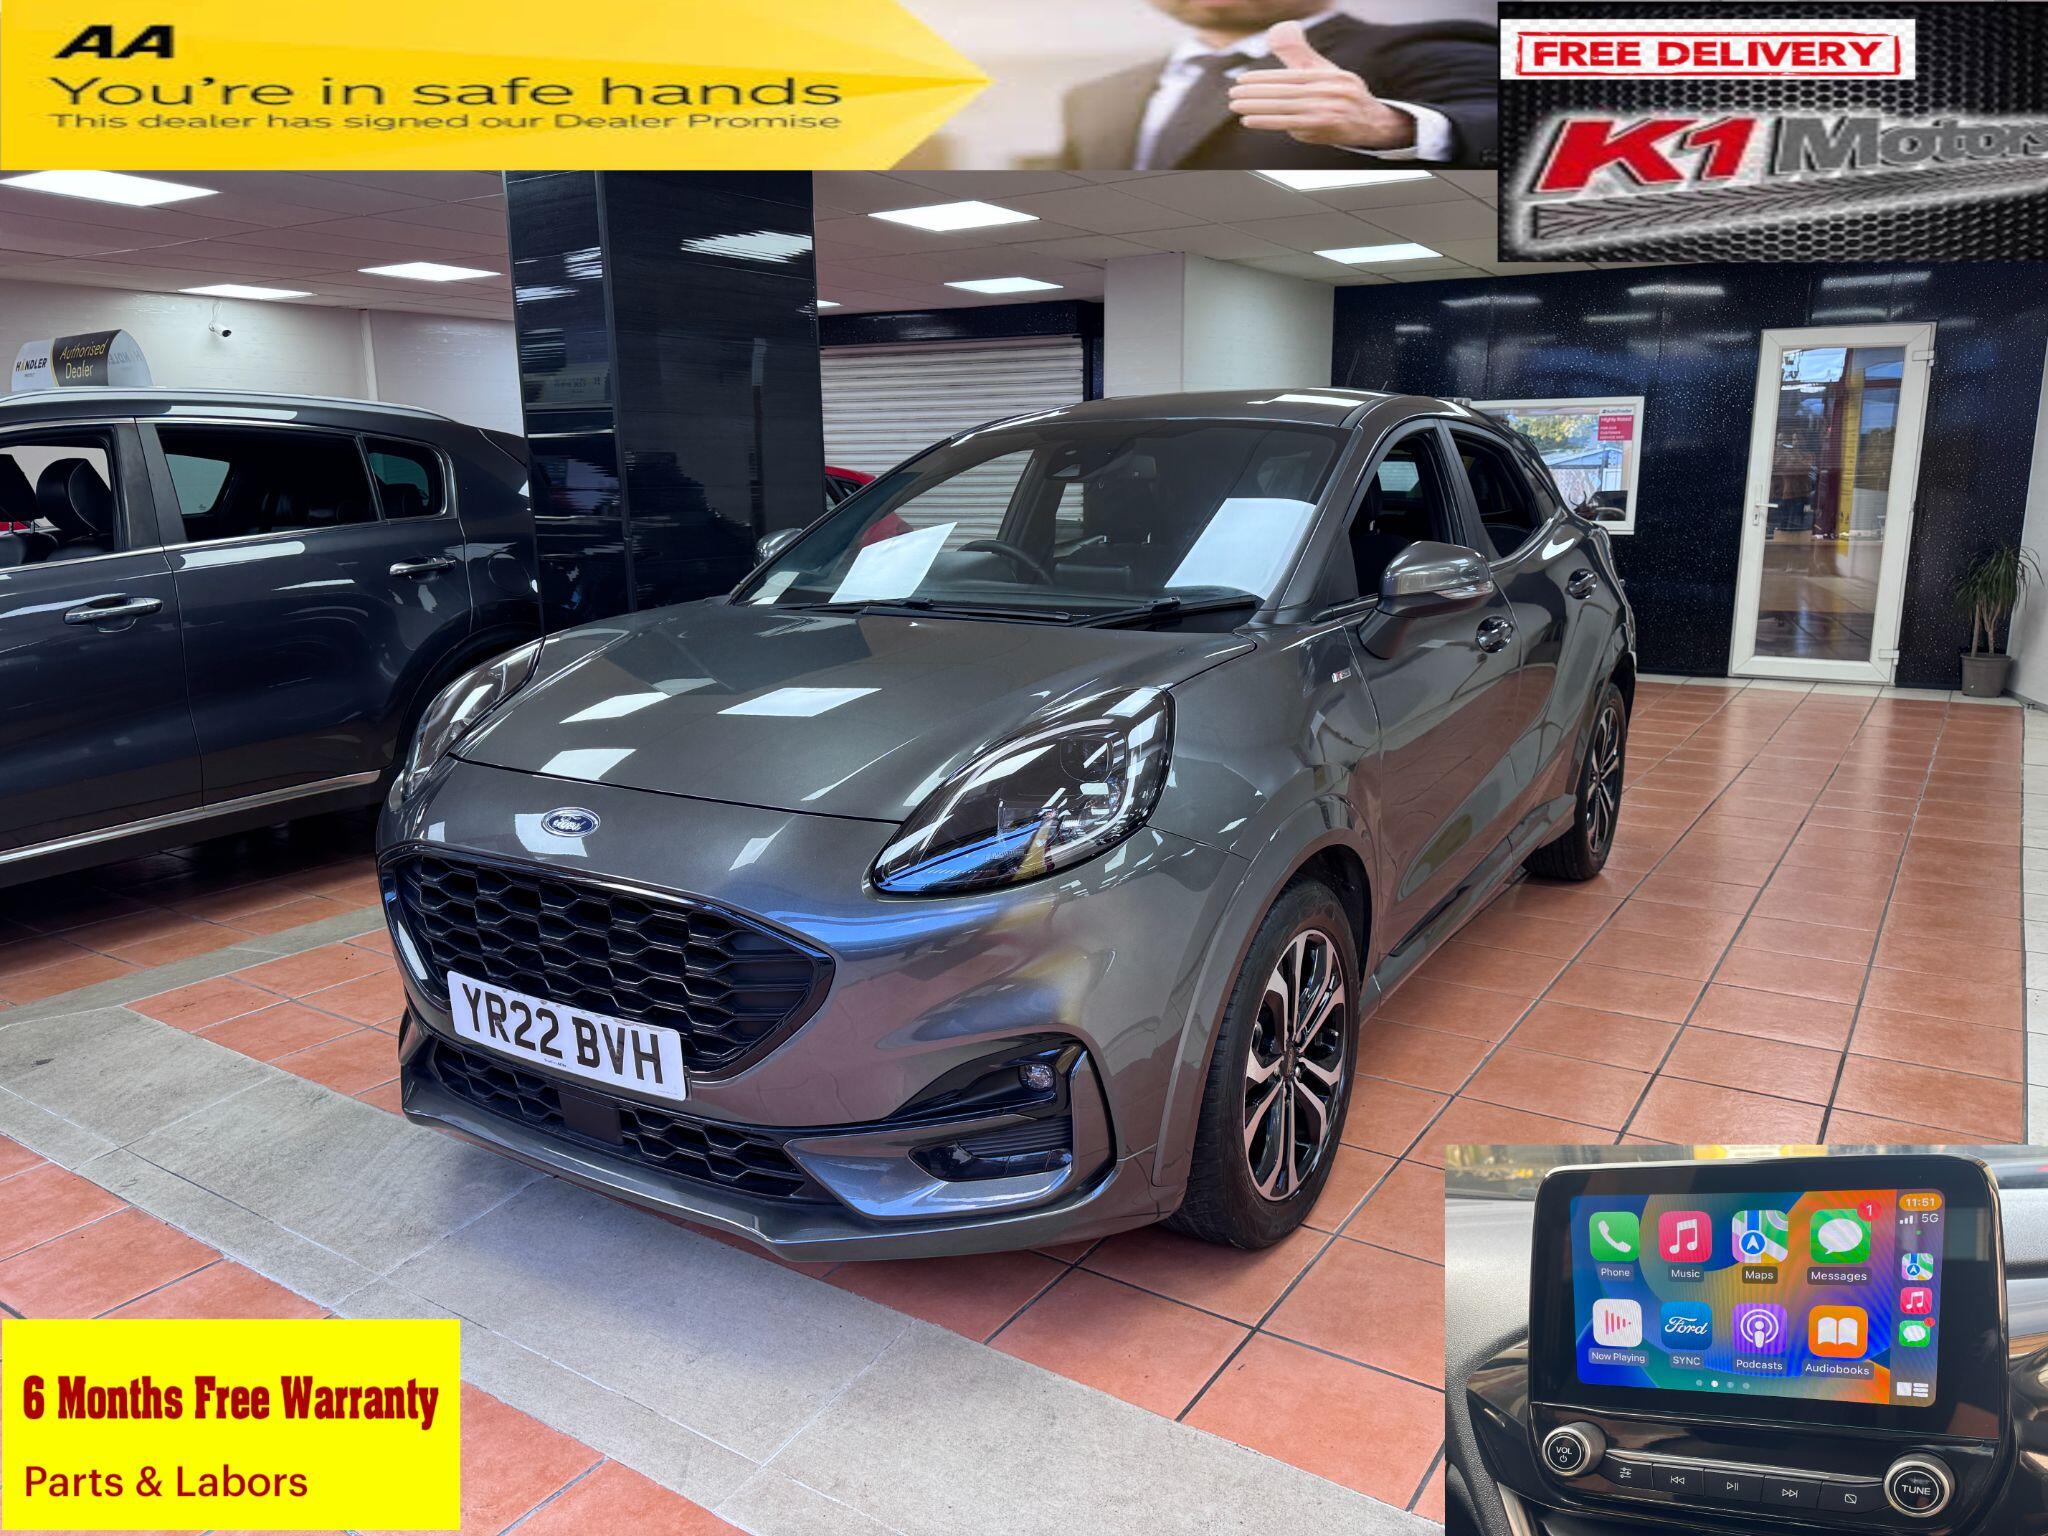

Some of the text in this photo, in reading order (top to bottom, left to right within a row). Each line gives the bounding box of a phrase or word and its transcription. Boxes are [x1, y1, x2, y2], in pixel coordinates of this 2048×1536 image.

[60, 338, 109, 361] Authorised
[65, 362, 94, 380] Dealer
[462, 983, 664, 1084] YR22 BVH
[1905, 1197, 1936, 1208] 11:51
[1866, 1204, 1873, 1217] 1
[1921, 1213, 1940, 1223] 5G
[1601, 1267, 1631, 1278] Phone
[1671, 1268, 1701, 1279] Music
[1745, 1270, 1774, 1282] Maps
[1811, 1270, 1868, 1283] Messages
[1664, 1316, 1708, 1335] Ford
[1591, 1351, 1646, 1365] Now Playing
[1672, 1355, 1701, 1366] SYNC
[1736, 1359, 1784, 1371] Podcasts
[1805, 1363, 1870, 1377] Audiobooks
[1555, 1446, 1573, 1456] VOL
[1901, 1484, 1931, 1497] TUNE
